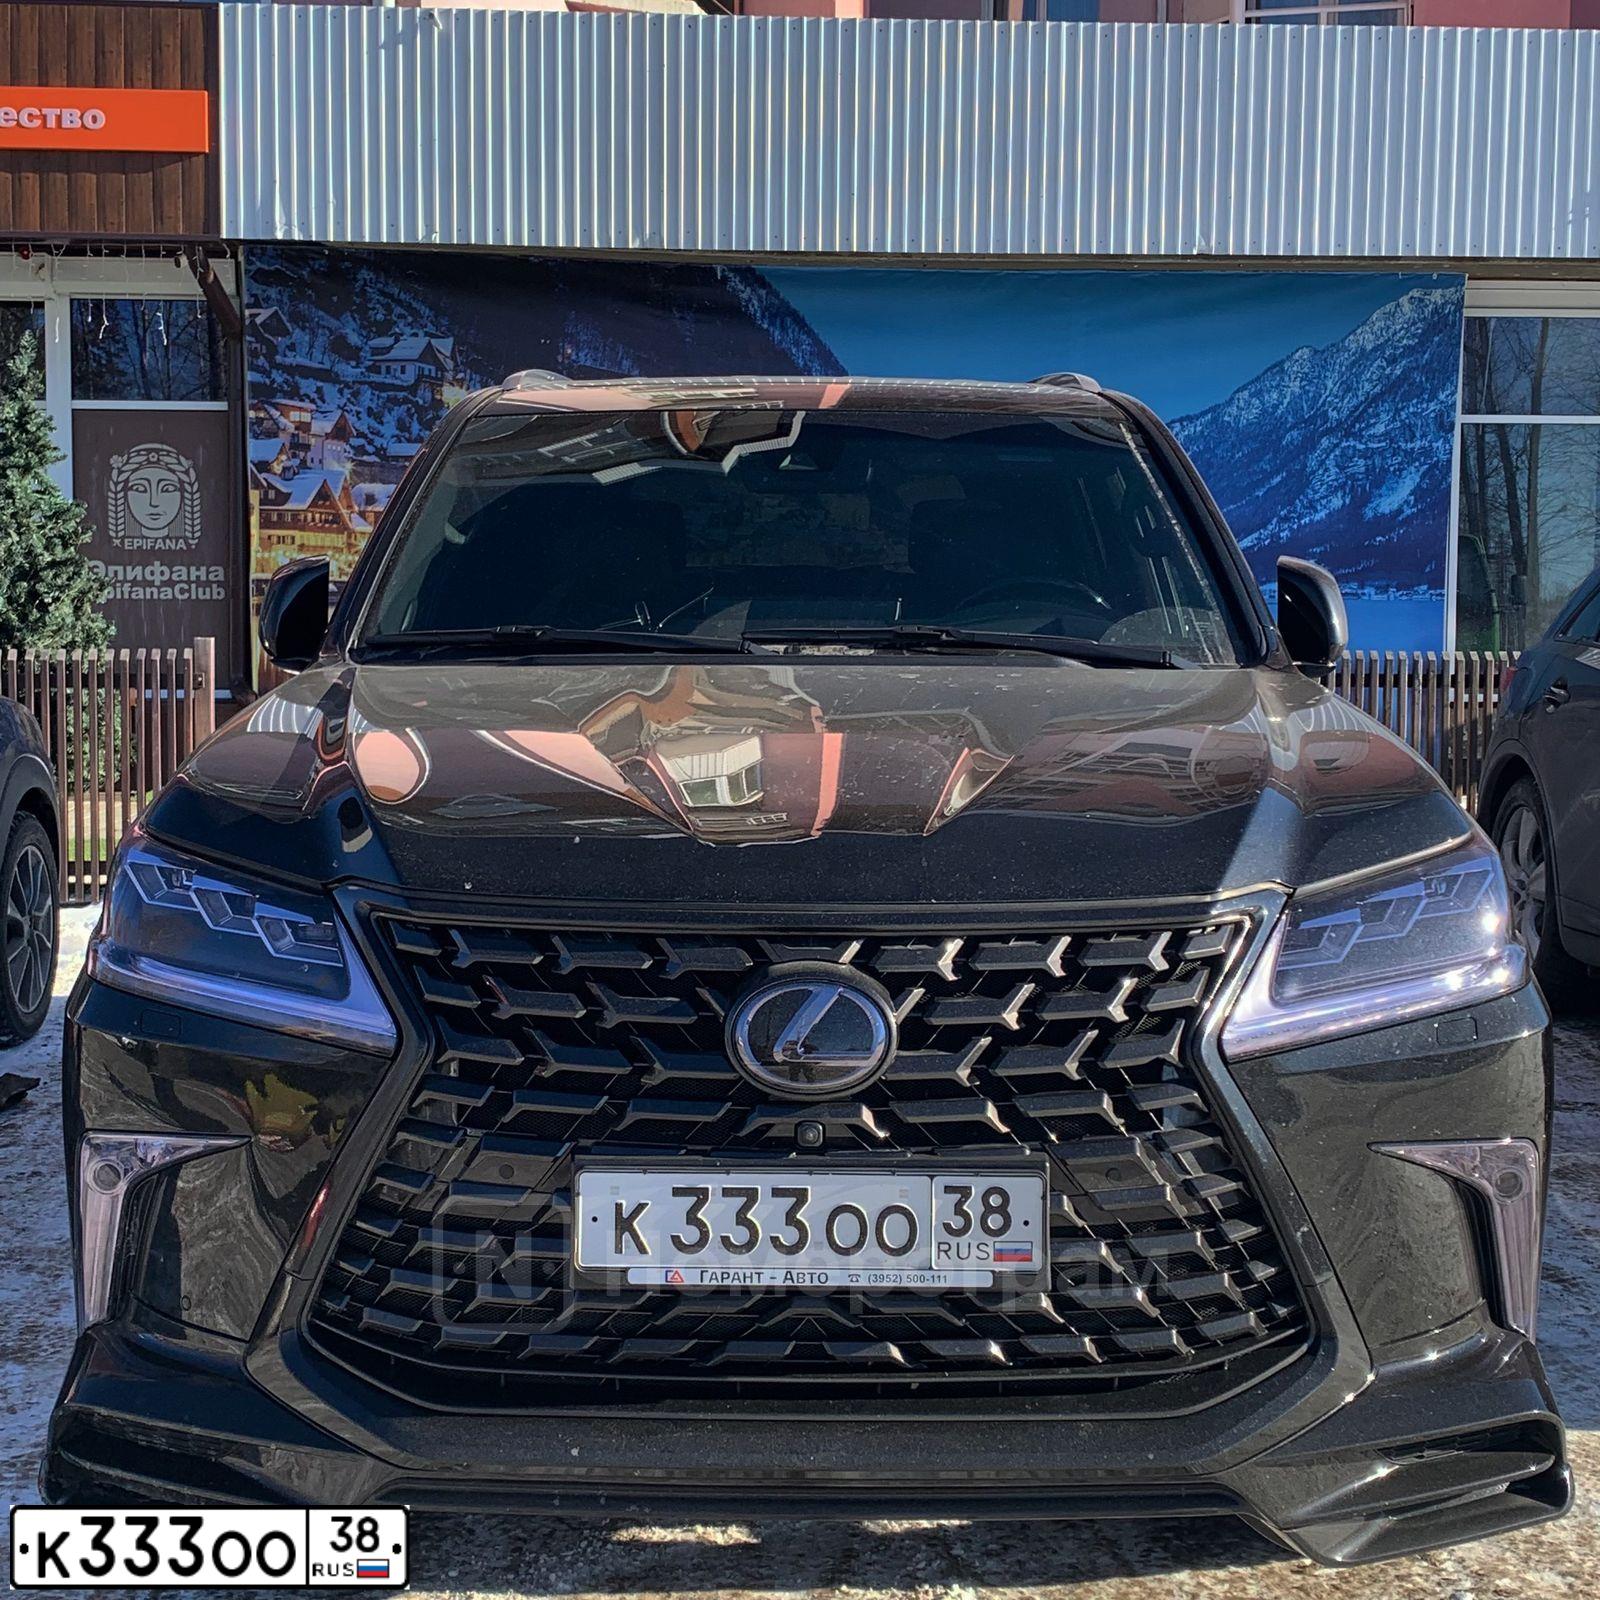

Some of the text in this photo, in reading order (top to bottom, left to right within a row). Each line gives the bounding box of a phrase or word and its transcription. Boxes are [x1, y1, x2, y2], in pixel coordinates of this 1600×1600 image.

[124, 538, 187, 550] EPIFANA
[88, 560, 225, 585] Эпифана
[93, 582, 226, 601] pifanaClub
[942, 1185, 1011, 1237] 38
[936, 1241, 990, 1262] RUS
[867, 1273, 948, 1285] (3952) 500-111
